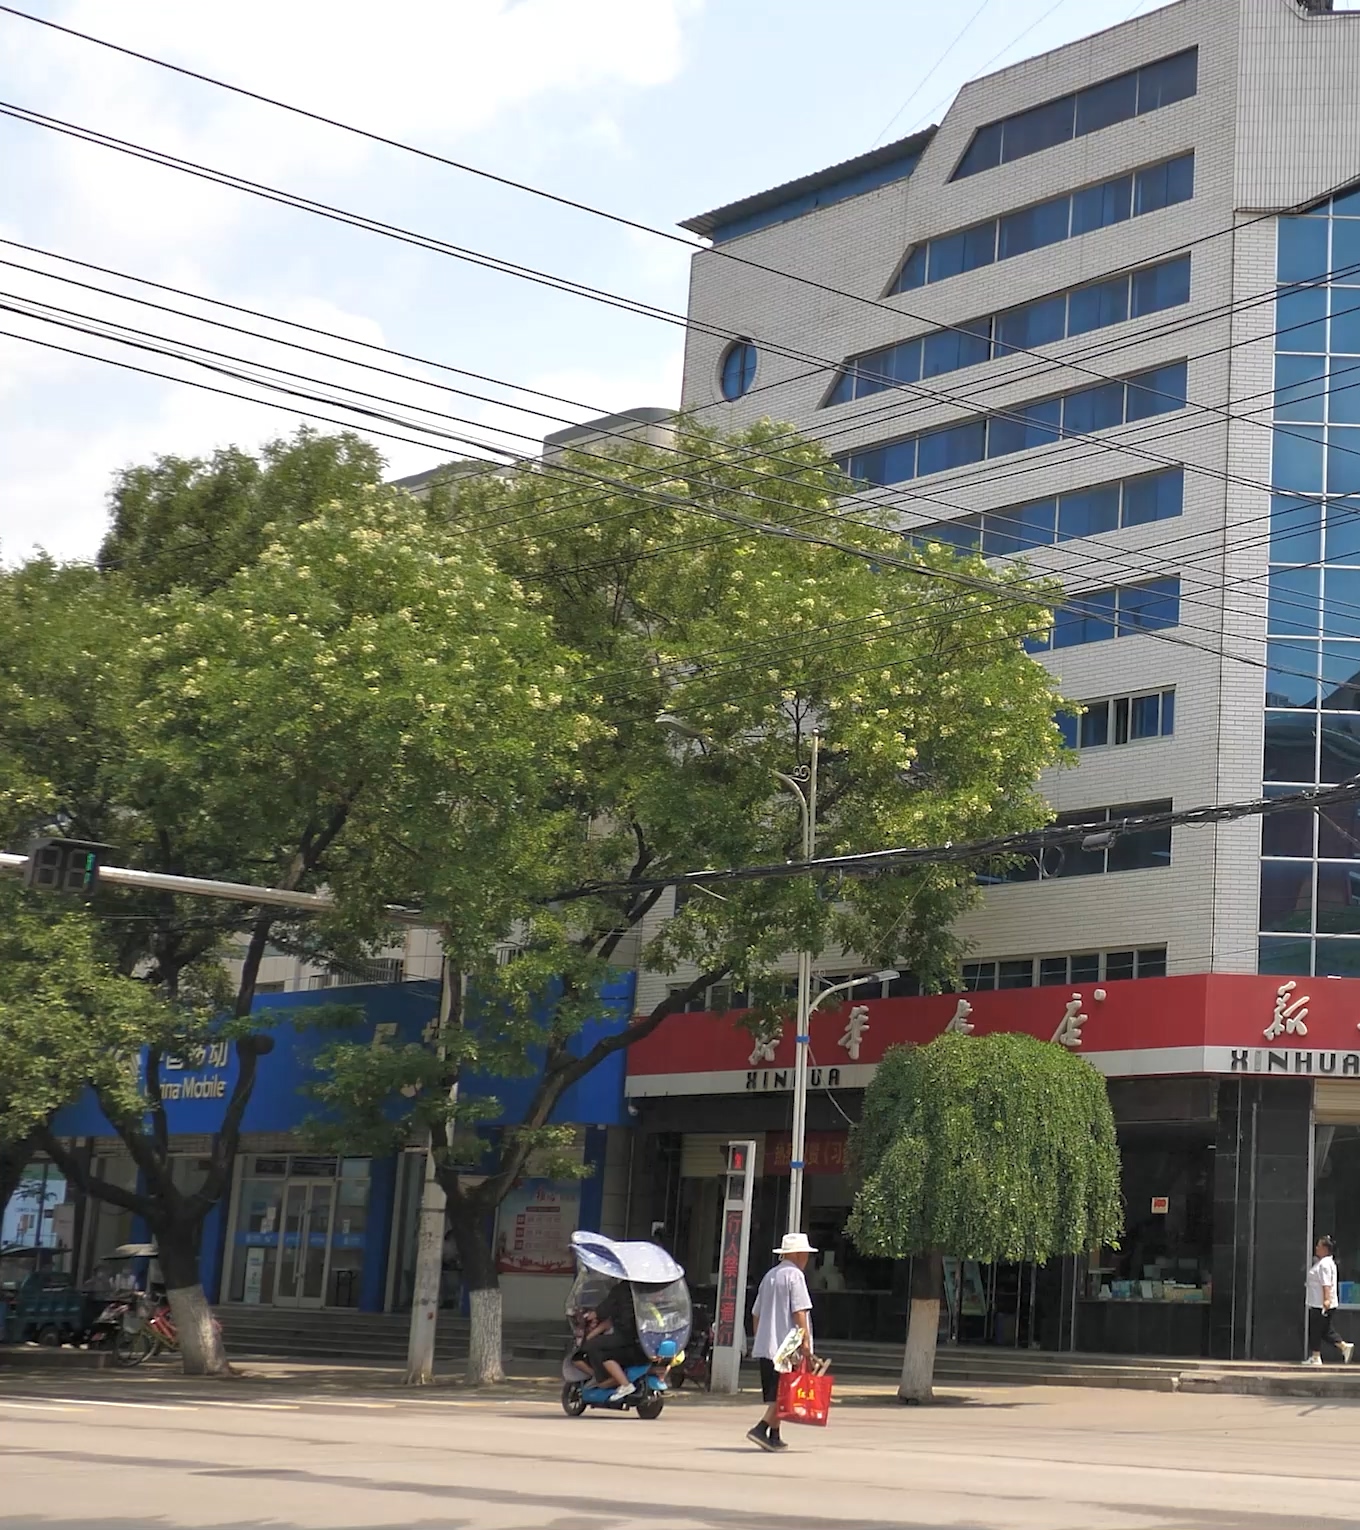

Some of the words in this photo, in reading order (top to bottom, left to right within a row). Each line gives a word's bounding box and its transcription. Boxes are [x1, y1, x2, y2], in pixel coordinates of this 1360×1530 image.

[182, 1073, 227, 1099] Mobile
[746, 1068, 840, 1090] XINUA
[717, 1212, 742, 1346] 行人禁止通行
